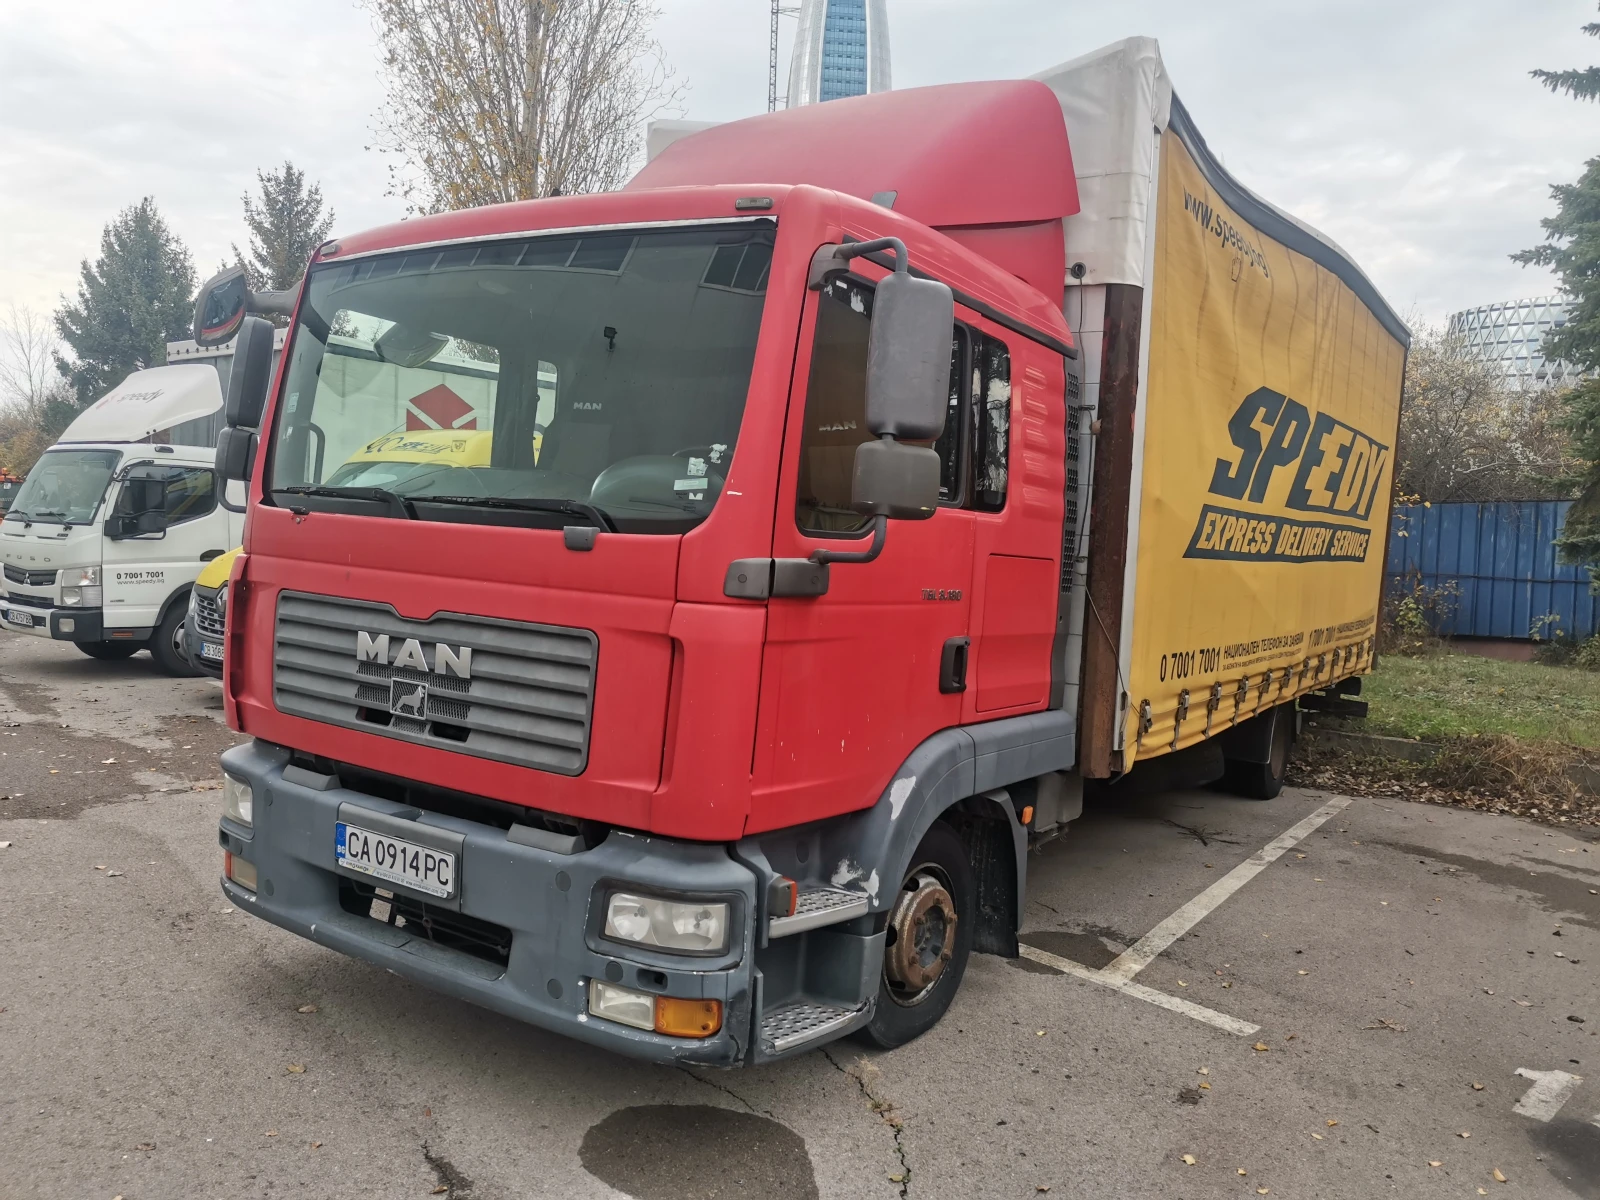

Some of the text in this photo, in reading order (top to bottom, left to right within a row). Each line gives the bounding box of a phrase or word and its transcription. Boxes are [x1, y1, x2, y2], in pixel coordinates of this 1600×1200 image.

[573, 402, 602, 410] MAN
[1207, 386, 1389, 521] SPEEDY
[1196, 512, 1368, 558] EXPRESS DELIVERY SERVICE
[145, 571, 164, 579] 7001
[356, 630, 472, 679] MAN
[1159, 654, 1167, 682] 0
[1170, 650, 1196, 680] 7001
[1198, 647, 1221, 674] 7001
